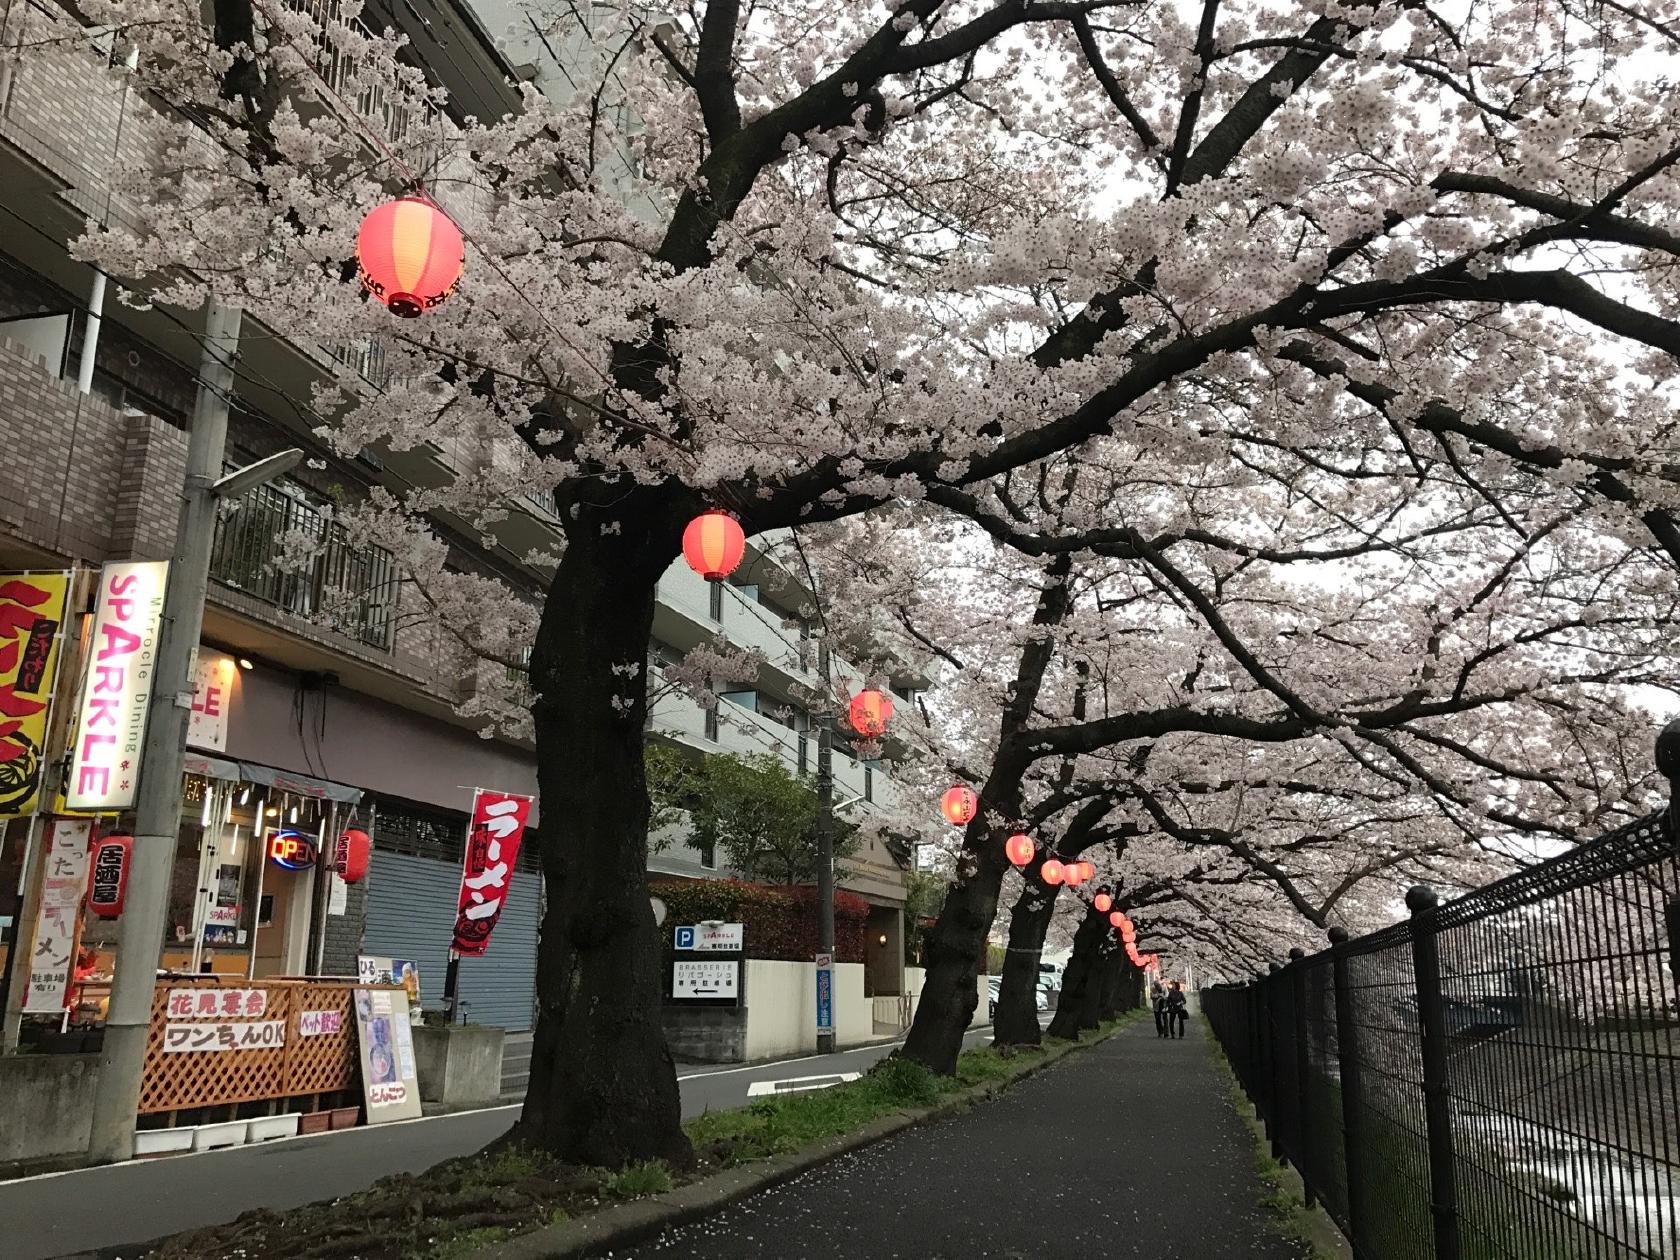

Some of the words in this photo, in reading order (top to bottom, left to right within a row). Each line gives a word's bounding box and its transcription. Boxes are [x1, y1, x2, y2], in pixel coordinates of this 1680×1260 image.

[78, 574, 142, 796] SPARKLE
[125, 693, 148, 753] Dining
[93, 845, 124, 903] 居酒屋
[271, 838, 317, 863] OPEN
[465, 800, 520, 921] ラーメン
[681, 931, 691, 946] P
[170, 991, 264, 1015] 花見宴会
